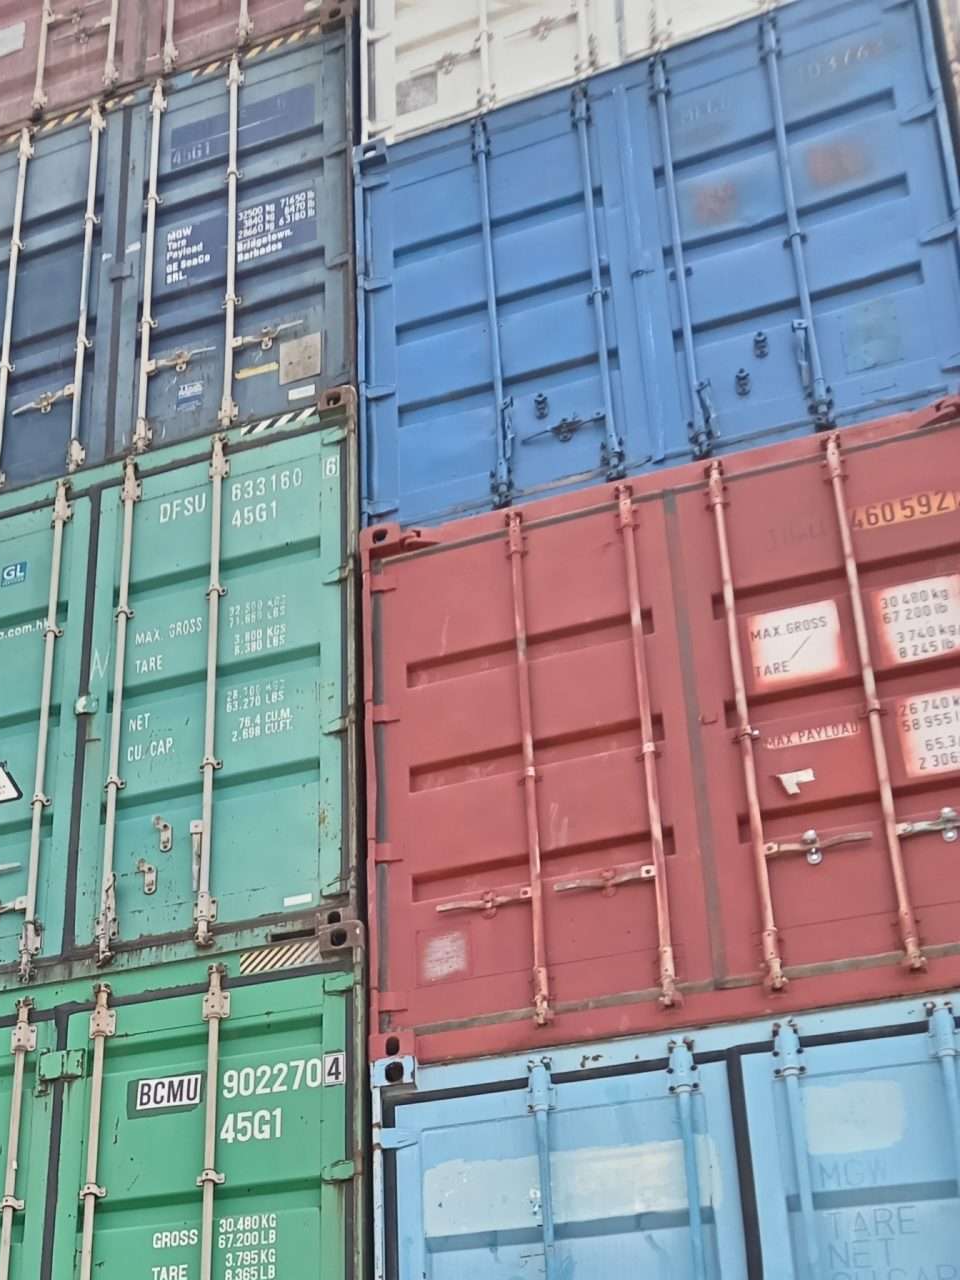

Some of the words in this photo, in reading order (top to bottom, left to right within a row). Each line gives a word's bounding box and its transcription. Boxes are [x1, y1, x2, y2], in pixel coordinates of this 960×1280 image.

[160, 493, 207, 524] DFSU
[231, 467, 303, 502] 633160
[231, 501, 278, 528] 45G1
[3, 564, 26, 580] GL
[169, 616, 203, 638] GROSS
[135, 655, 163, 674] TARE
[754, 660, 790, 678] TARE
[129, 712, 151, 731] NET
[138, 1075, 200, 1107] BCMU
[222, 1058, 322, 1098] 902270
[220, 1107, 282, 1144] 45G1
[152, 1229, 198, 1248] GROSS
[219, 1215, 259, 1233] 30.480
[261, 1213, 277, 1228] KG
[826, 1205, 920, 1240] TARE
[218, 1231, 259, 1249] 67.200
[261, 1229, 276, 1245] LB
[225, 1249, 258, 1267] 3.795
[260, 1248, 276, 1263] KG
[828, 1237, 896, 1270] NET
[260, 1264, 276, 1280] LB
